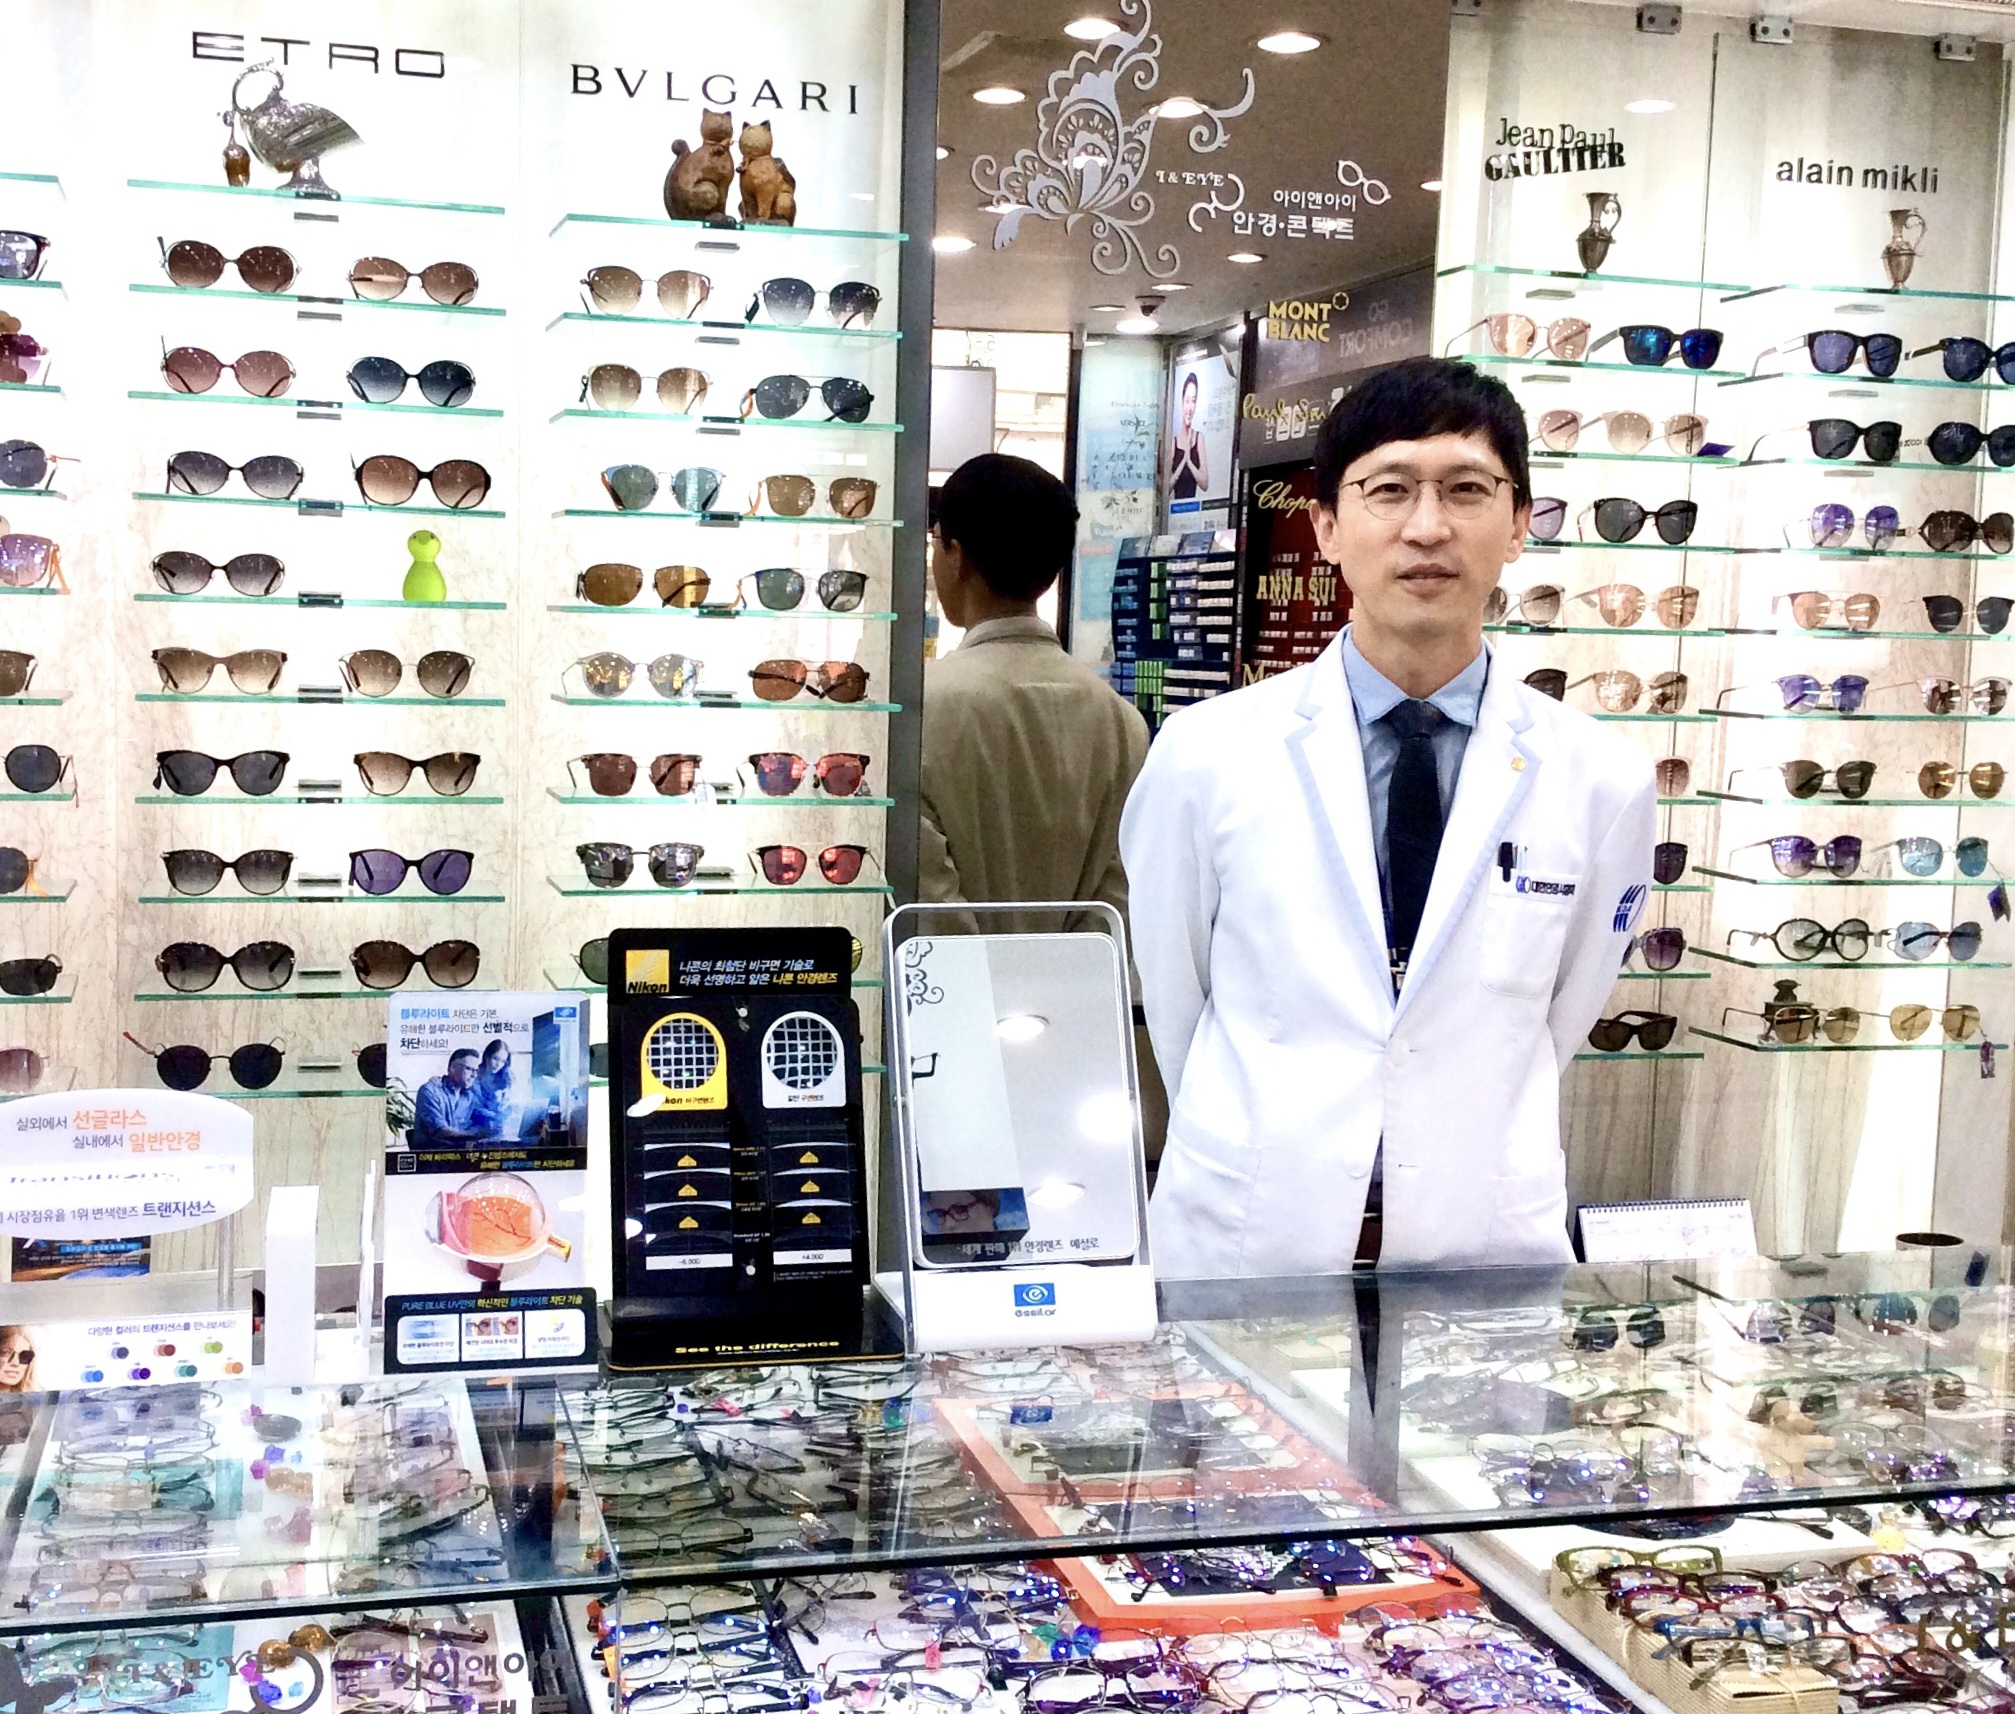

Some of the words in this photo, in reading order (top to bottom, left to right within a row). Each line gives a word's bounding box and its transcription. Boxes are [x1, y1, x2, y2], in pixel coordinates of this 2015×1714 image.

[191, 30, 445, 78] ETRO
[570, 63, 858, 115] BVLGARI
[1496, 117, 1554, 148] Jean
[1559, 123, 1615, 152] Paul
[1485, 142, 1626, 182] GAULTIER
[1156, 171, 1165, 183] I
[1167, 173, 1178, 183] &
[1182, 172, 1225, 187] EYE
[1775, 157, 1854, 187] alain
[1861, 163, 1939, 194] mikli
[1273, 189, 1357, 212] 아이앤아이
[1268, 300, 1331, 322] MONT
[1267, 321, 1331, 342] BLANC
[1253, 479, 1312, 518] Chopa
[1256, 575, 1304, 600] ANNA
[1307, 576, 1337, 602] SUI
[679, 960, 713, 972] 니콘의
[748, 959, 780, 972] 비구면
[783, 959, 815, 971] 기술로
[627, 981, 668, 993] Nikon
[703, 973, 747, 986] 선명하고
[772, 972, 795, 985] 니콘
[796, 972, 839, 984] 안경렌즈
[401, 1007, 450, 1020] 블루라이트
[452, 1008, 478, 1019] 차단은
[400, 1037, 449, 1050] 차단하세요!
[16, 1116, 68, 1131] 실외에서
[73, 1110, 148, 1130] 선글라스
[72, 1135, 124, 1150] 실내에서
[128, 1131, 202, 1153] 일반안경
[7, 1208, 66, 1224] 시장점유율
[71, 1208, 90, 1222] 1위
[92, 1206, 139, 1221] 변색렌즈
[142, 1199, 217, 1219] 트랜지션스
[1024, 1239, 1065, 1253] 안경렌즈
[1069, 1237, 1100, 1251] 에실로
[401, 1301, 424, 1311] PURE
[425, 1300, 447, 1310] BLUE
[1014, 1307, 1057, 1318] essilor
[675, 1346, 709, 1354] See
[748, 1341, 840, 1351] difference
